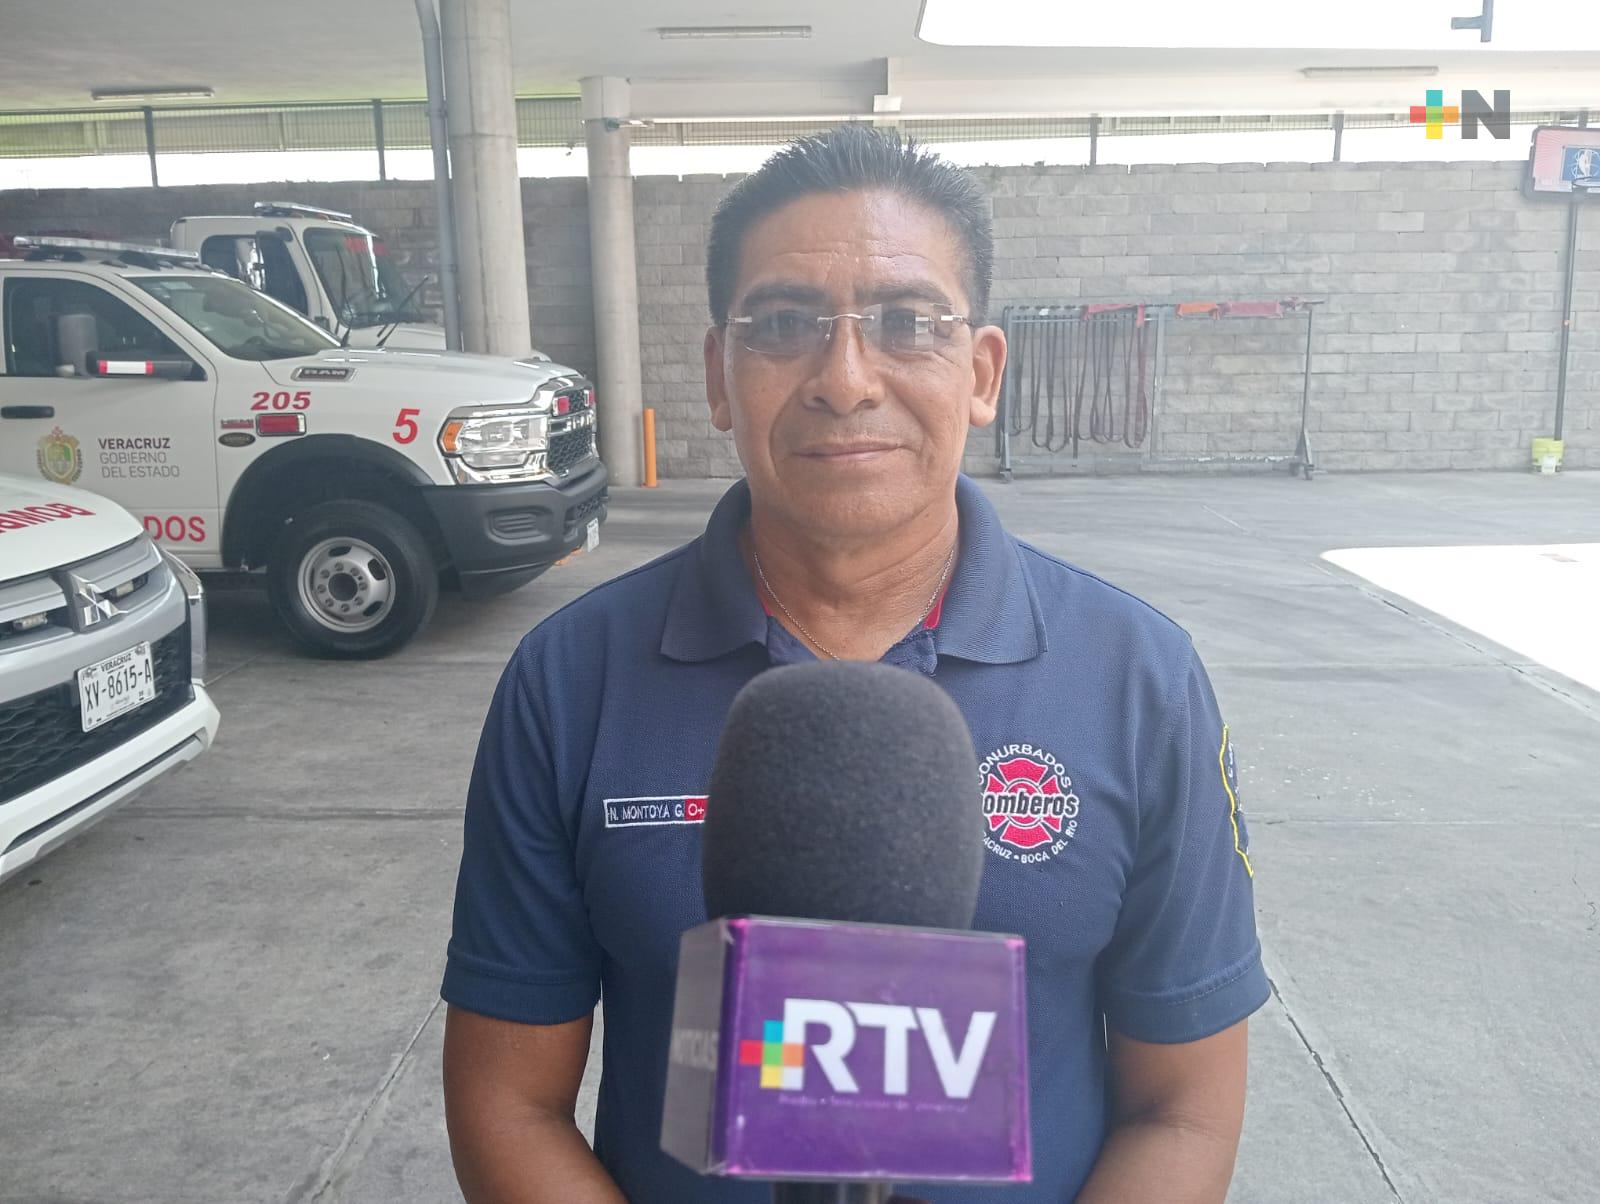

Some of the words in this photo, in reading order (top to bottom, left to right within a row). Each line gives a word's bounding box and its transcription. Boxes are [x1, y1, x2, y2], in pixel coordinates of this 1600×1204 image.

[251, 391, 311, 411] 205
[392, 408, 420, 444] 5
[98, 437, 170, 450] VERACRUZ
[100, 451, 167, 465] GOBIERNO
[102, 466, 126, 478] DEL
[130, 465, 180, 478] ESTADO
[144, 516, 206, 542] DOS
[100, 653, 132, 672] VERACRUZ
[85, 658, 152, 713] XV-8615-A
[622, 804, 670, 820] MONTOYA
[982, 786, 1080, 818] omberos
[1020, 850, 1051, 864] BOCA
[1050, 839, 1069, 855] DEL
[783, 998, 997, 1099] RTV
